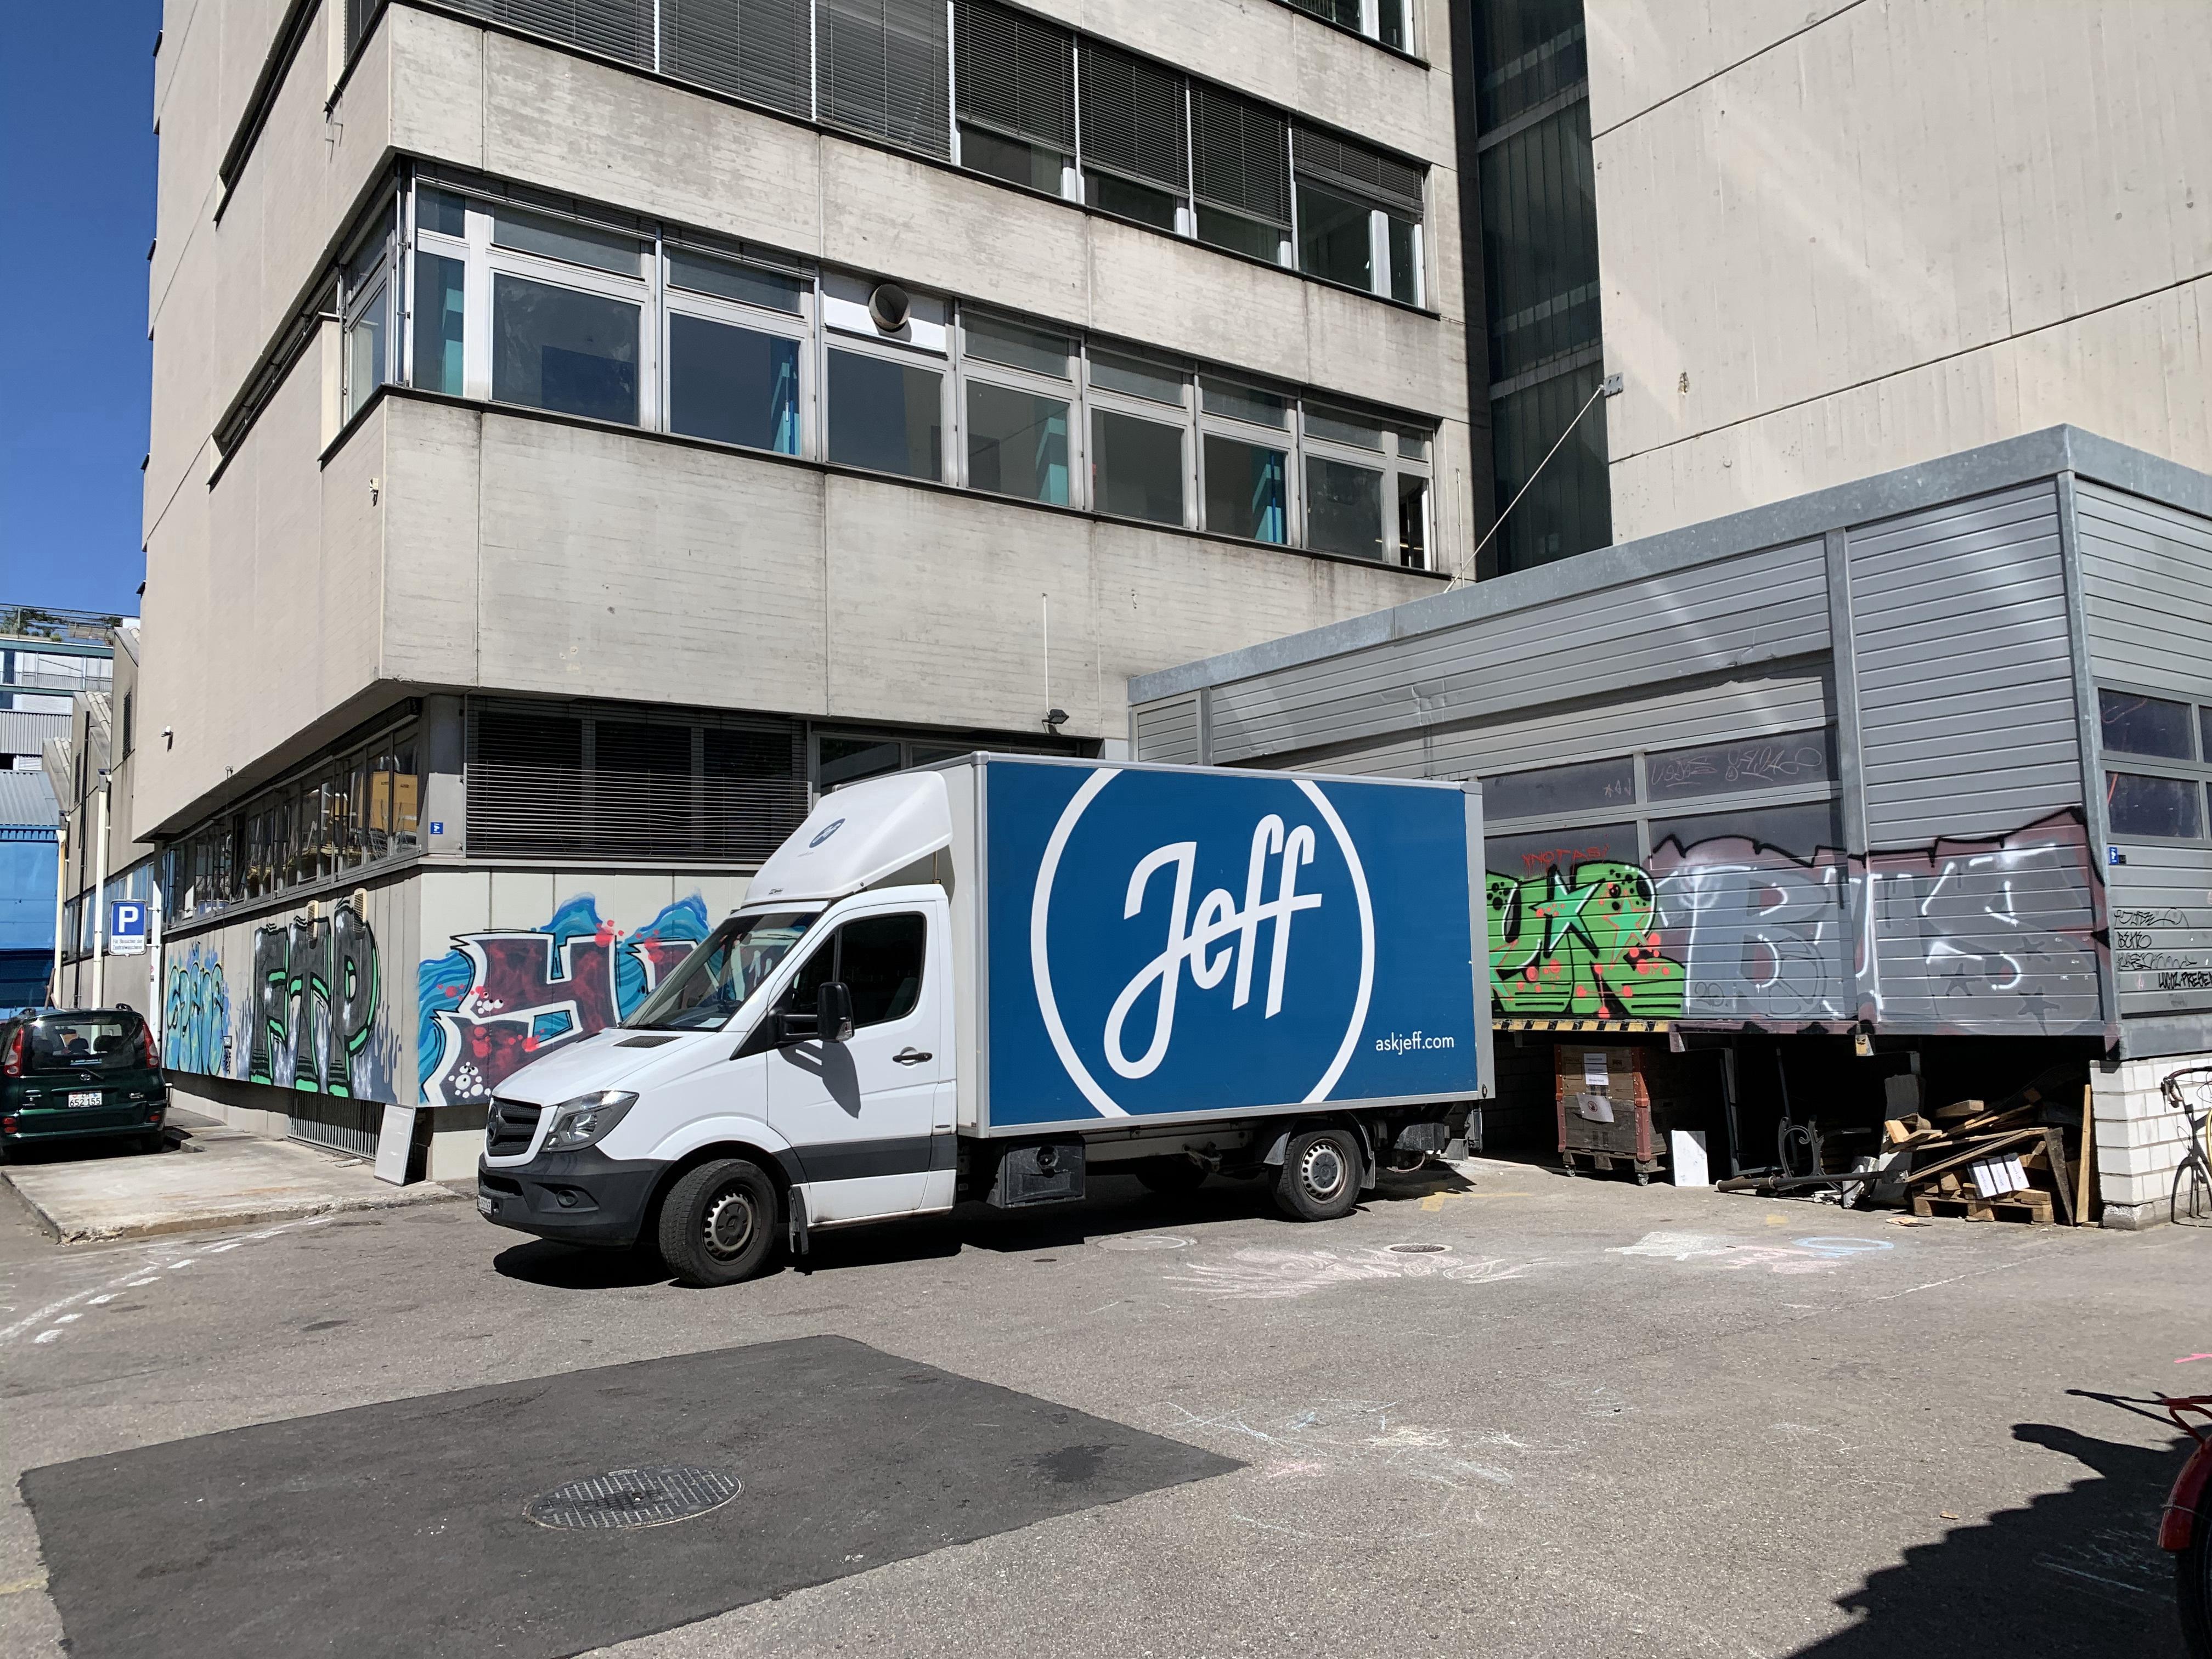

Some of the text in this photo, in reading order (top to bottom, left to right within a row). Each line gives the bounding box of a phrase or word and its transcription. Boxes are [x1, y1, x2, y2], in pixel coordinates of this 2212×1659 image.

[119, 906, 138, 933] P
[1104, 814, 1322, 1079] Jeff
[1375, 1030, 1454, 1055] askjeff.com
